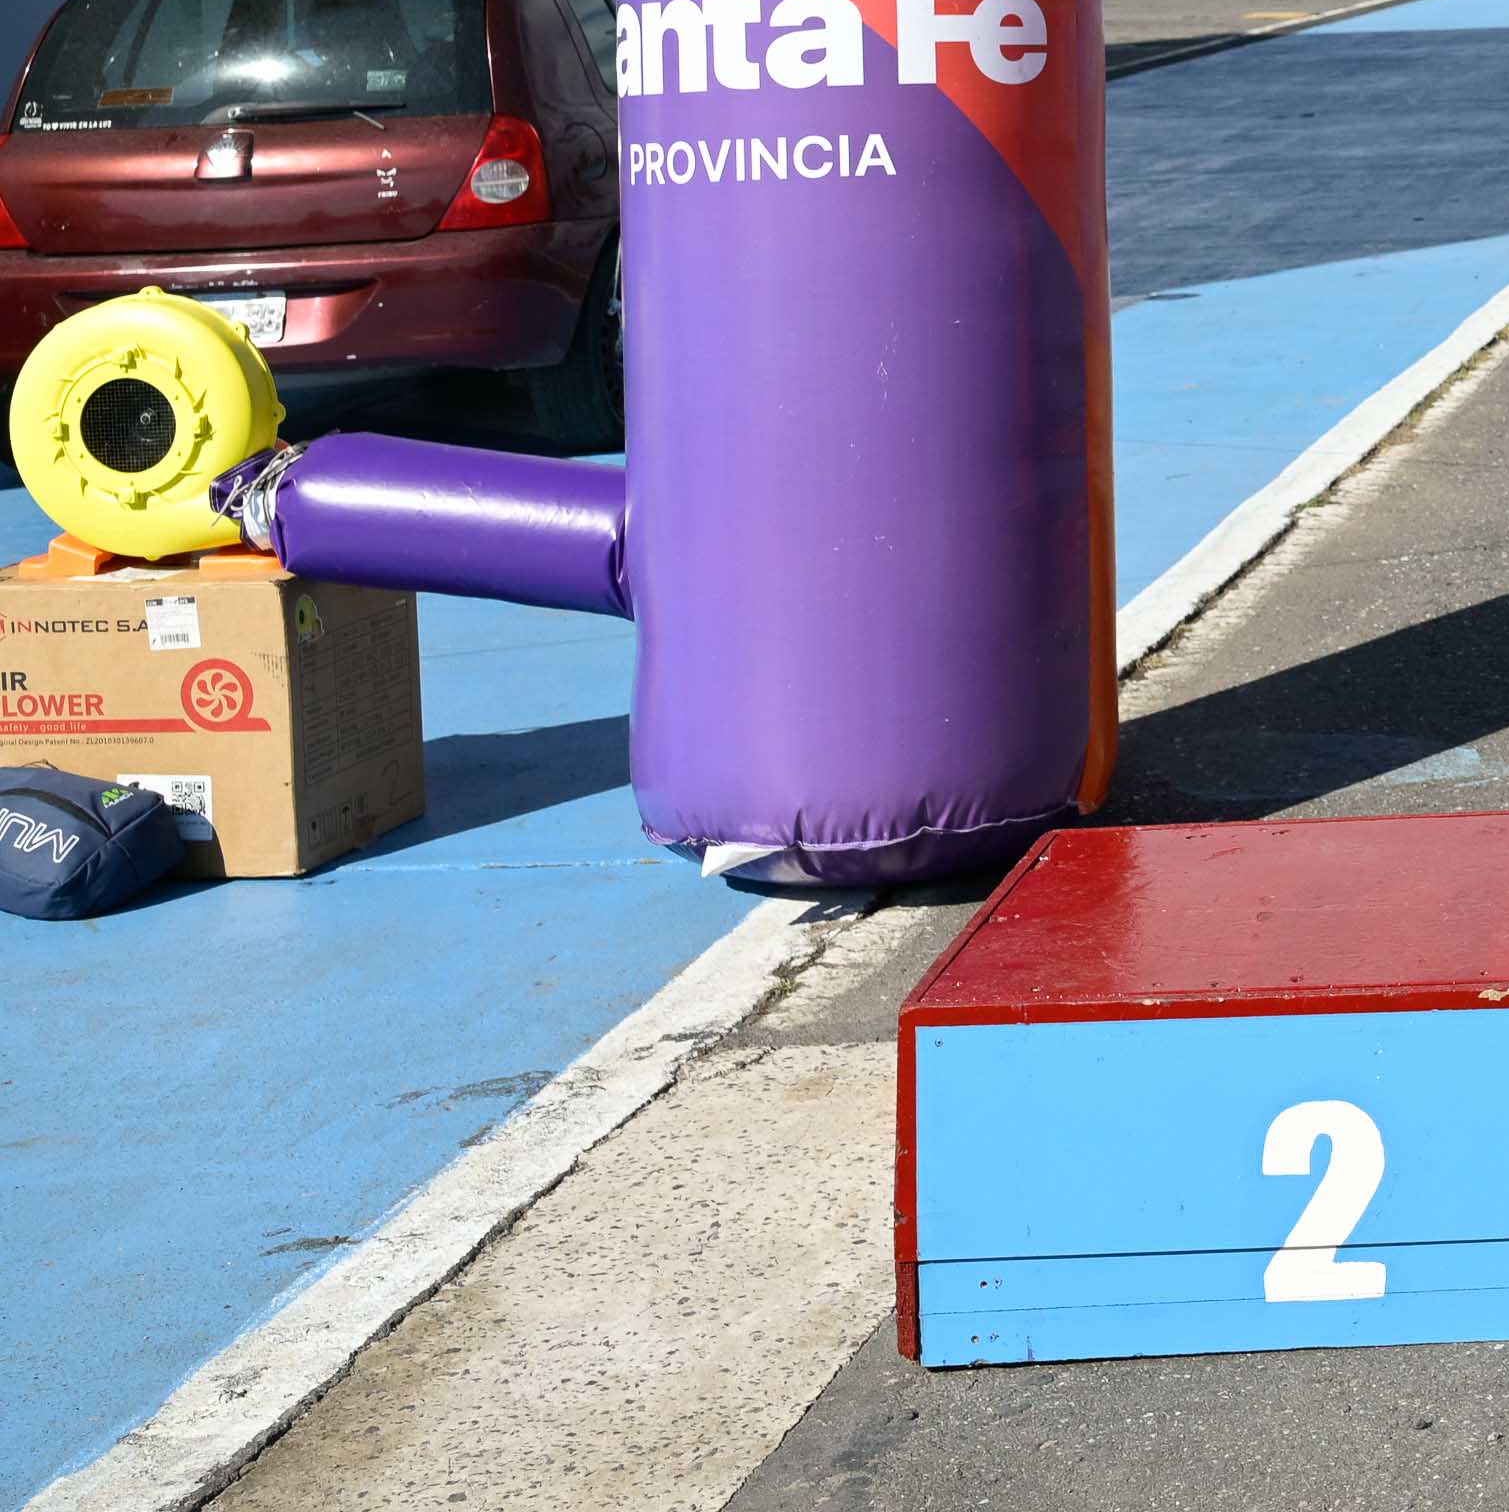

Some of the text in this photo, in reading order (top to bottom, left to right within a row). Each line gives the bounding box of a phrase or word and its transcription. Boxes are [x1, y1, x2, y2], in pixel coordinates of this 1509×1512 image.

[630, 133, 897, 186] PROVINCIA
[11, 619, 109, 634] INNOTEC
[0, 671, 28, 692] IR
[0, 694, 104, 718] LOWER
[40, 722, 66, 733] good
[0, 738, 17, 747] ginal
[0, 807, 80, 864] MU
[1261, 1100, 1387, 1303] 2
